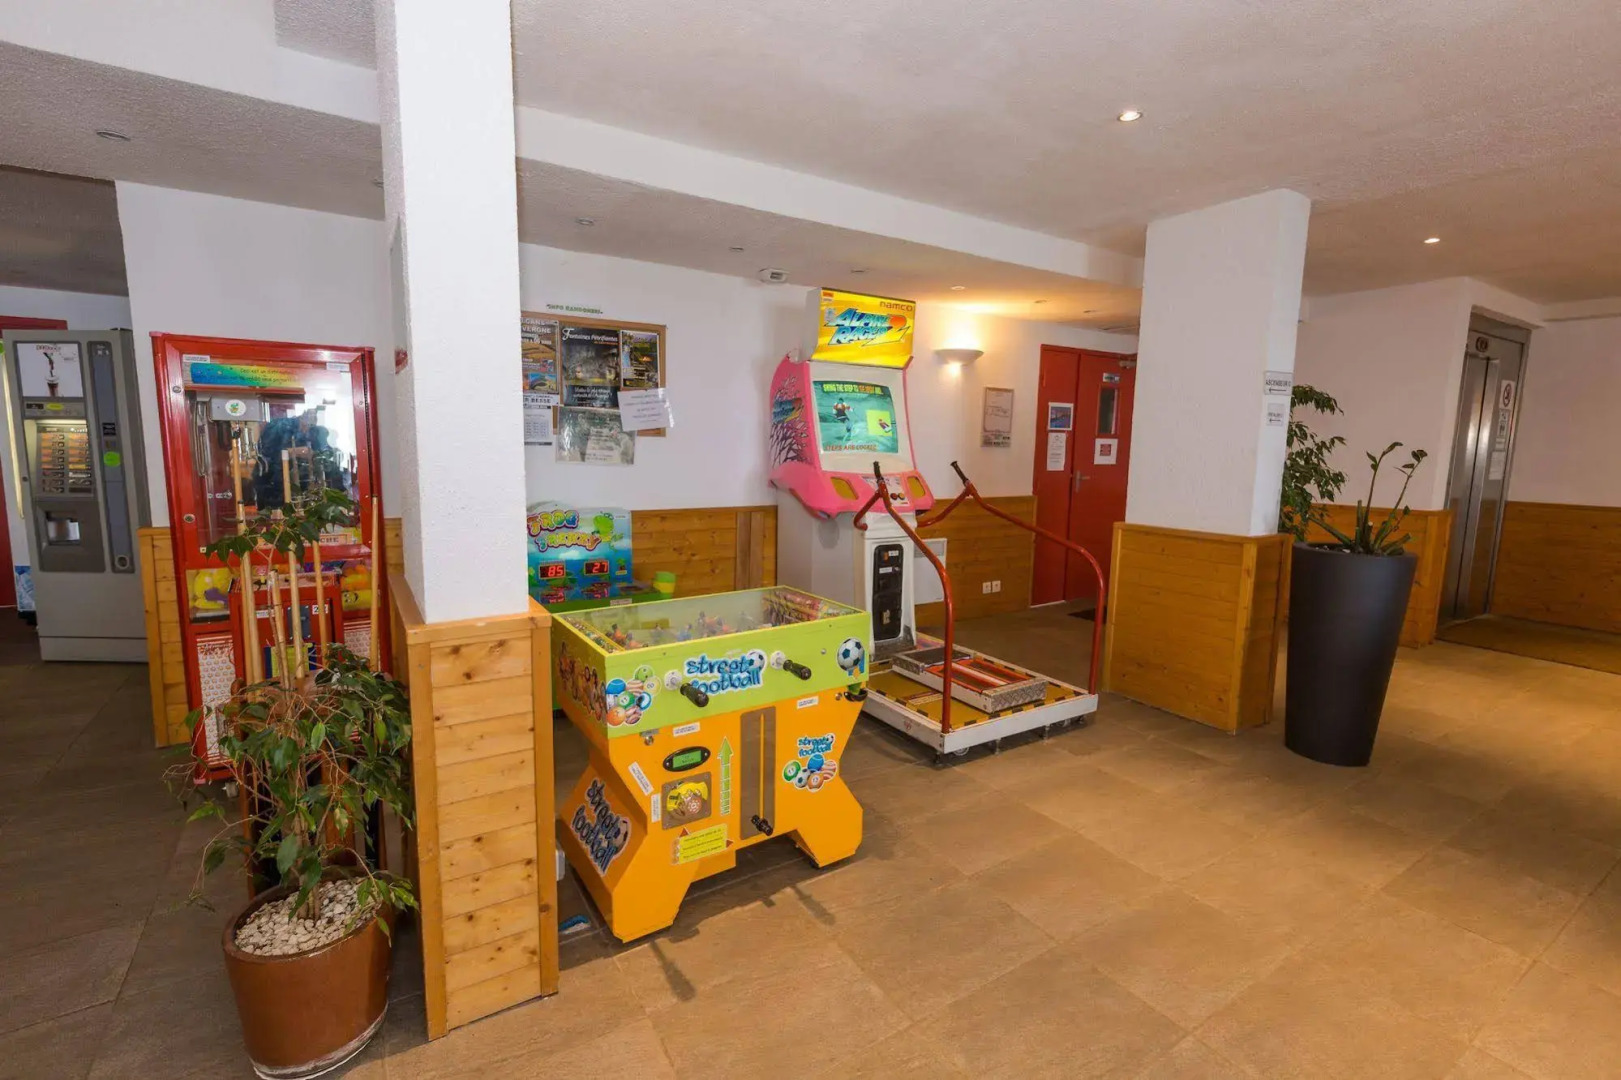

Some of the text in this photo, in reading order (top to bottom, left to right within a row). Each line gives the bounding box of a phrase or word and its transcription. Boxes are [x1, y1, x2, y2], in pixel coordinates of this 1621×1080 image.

[880, 301, 913, 312] namco
[824, 308, 890, 327] ALPINE
[522, 326, 552, 334] VERGNE
[828, 326, 888, 346] RACER
[547, 565, 564, 577] 85
[592, 562, 608, 573] 27
[686, 654, 750, 675] street
[798, 736, 828, 746] street
[798, 742, 833, 757] football
[586, 779, 621, 840] street
[572, 804, 617, 873] football
